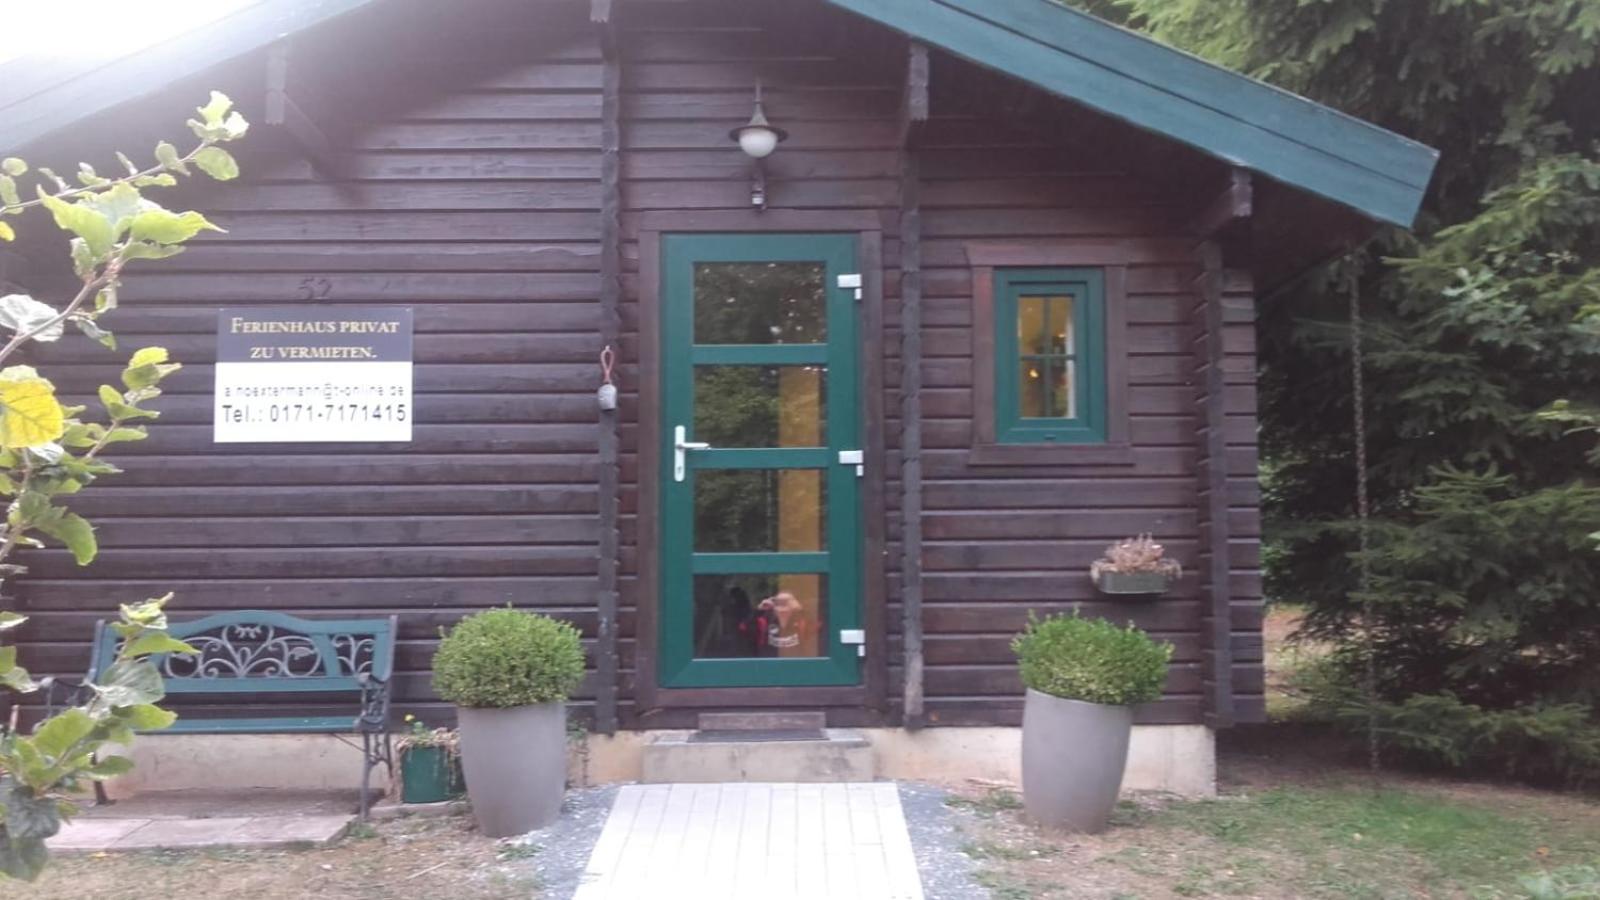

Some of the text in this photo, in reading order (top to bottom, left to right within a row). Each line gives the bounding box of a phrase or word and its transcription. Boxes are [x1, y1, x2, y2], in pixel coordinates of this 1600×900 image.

[298, 277, 332, 301] 52
[231, 317, 400, 334] FERIENHAUS PRIVAT
[250, 345, 378, 359] ZU VERMIETEN.
[222, 403, 406, 423] Tel.: 0171-7171415
